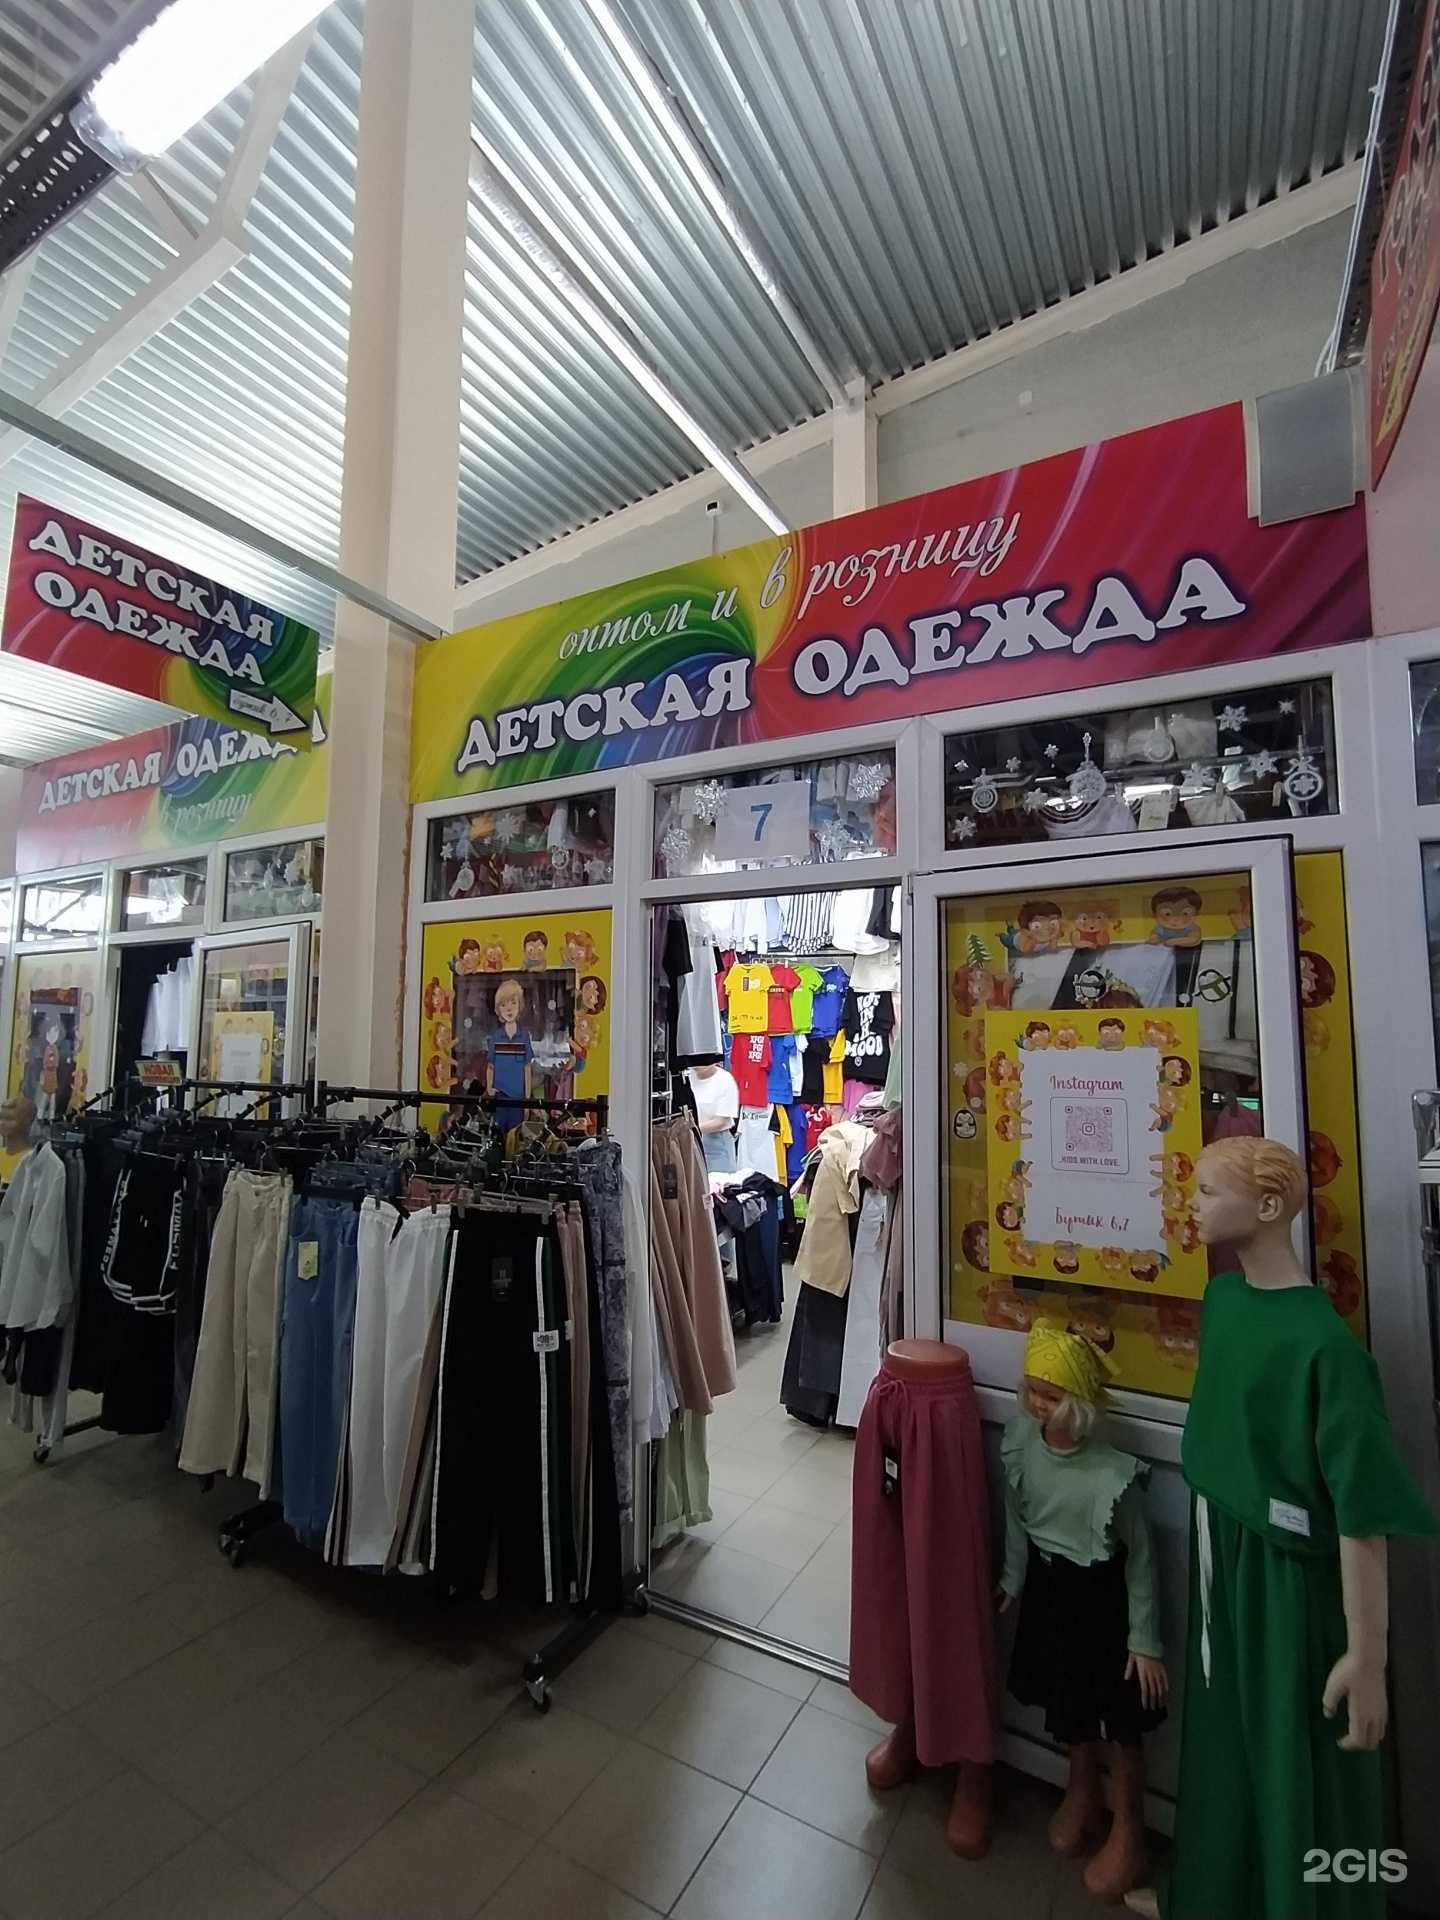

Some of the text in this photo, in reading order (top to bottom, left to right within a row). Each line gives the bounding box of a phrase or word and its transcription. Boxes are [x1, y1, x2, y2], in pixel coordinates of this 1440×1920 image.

[29, 520, 273, 646] ДЕТСКАЯ
[559, 511, 1021, 661] оптом и в розницу
[34, 571, 264, 685] ОДЕЖДА
[457, 558, 1246, 773] ДЕТСКАЯ ОДЕЖДА
[38, 752, 162, 814] ДЕТСКАЯ
[750, 803, 774, 842] 7
[1050, 1075, 1124, 1097] Instagram
[1055, 1206, 1104, 1233] Бутик
